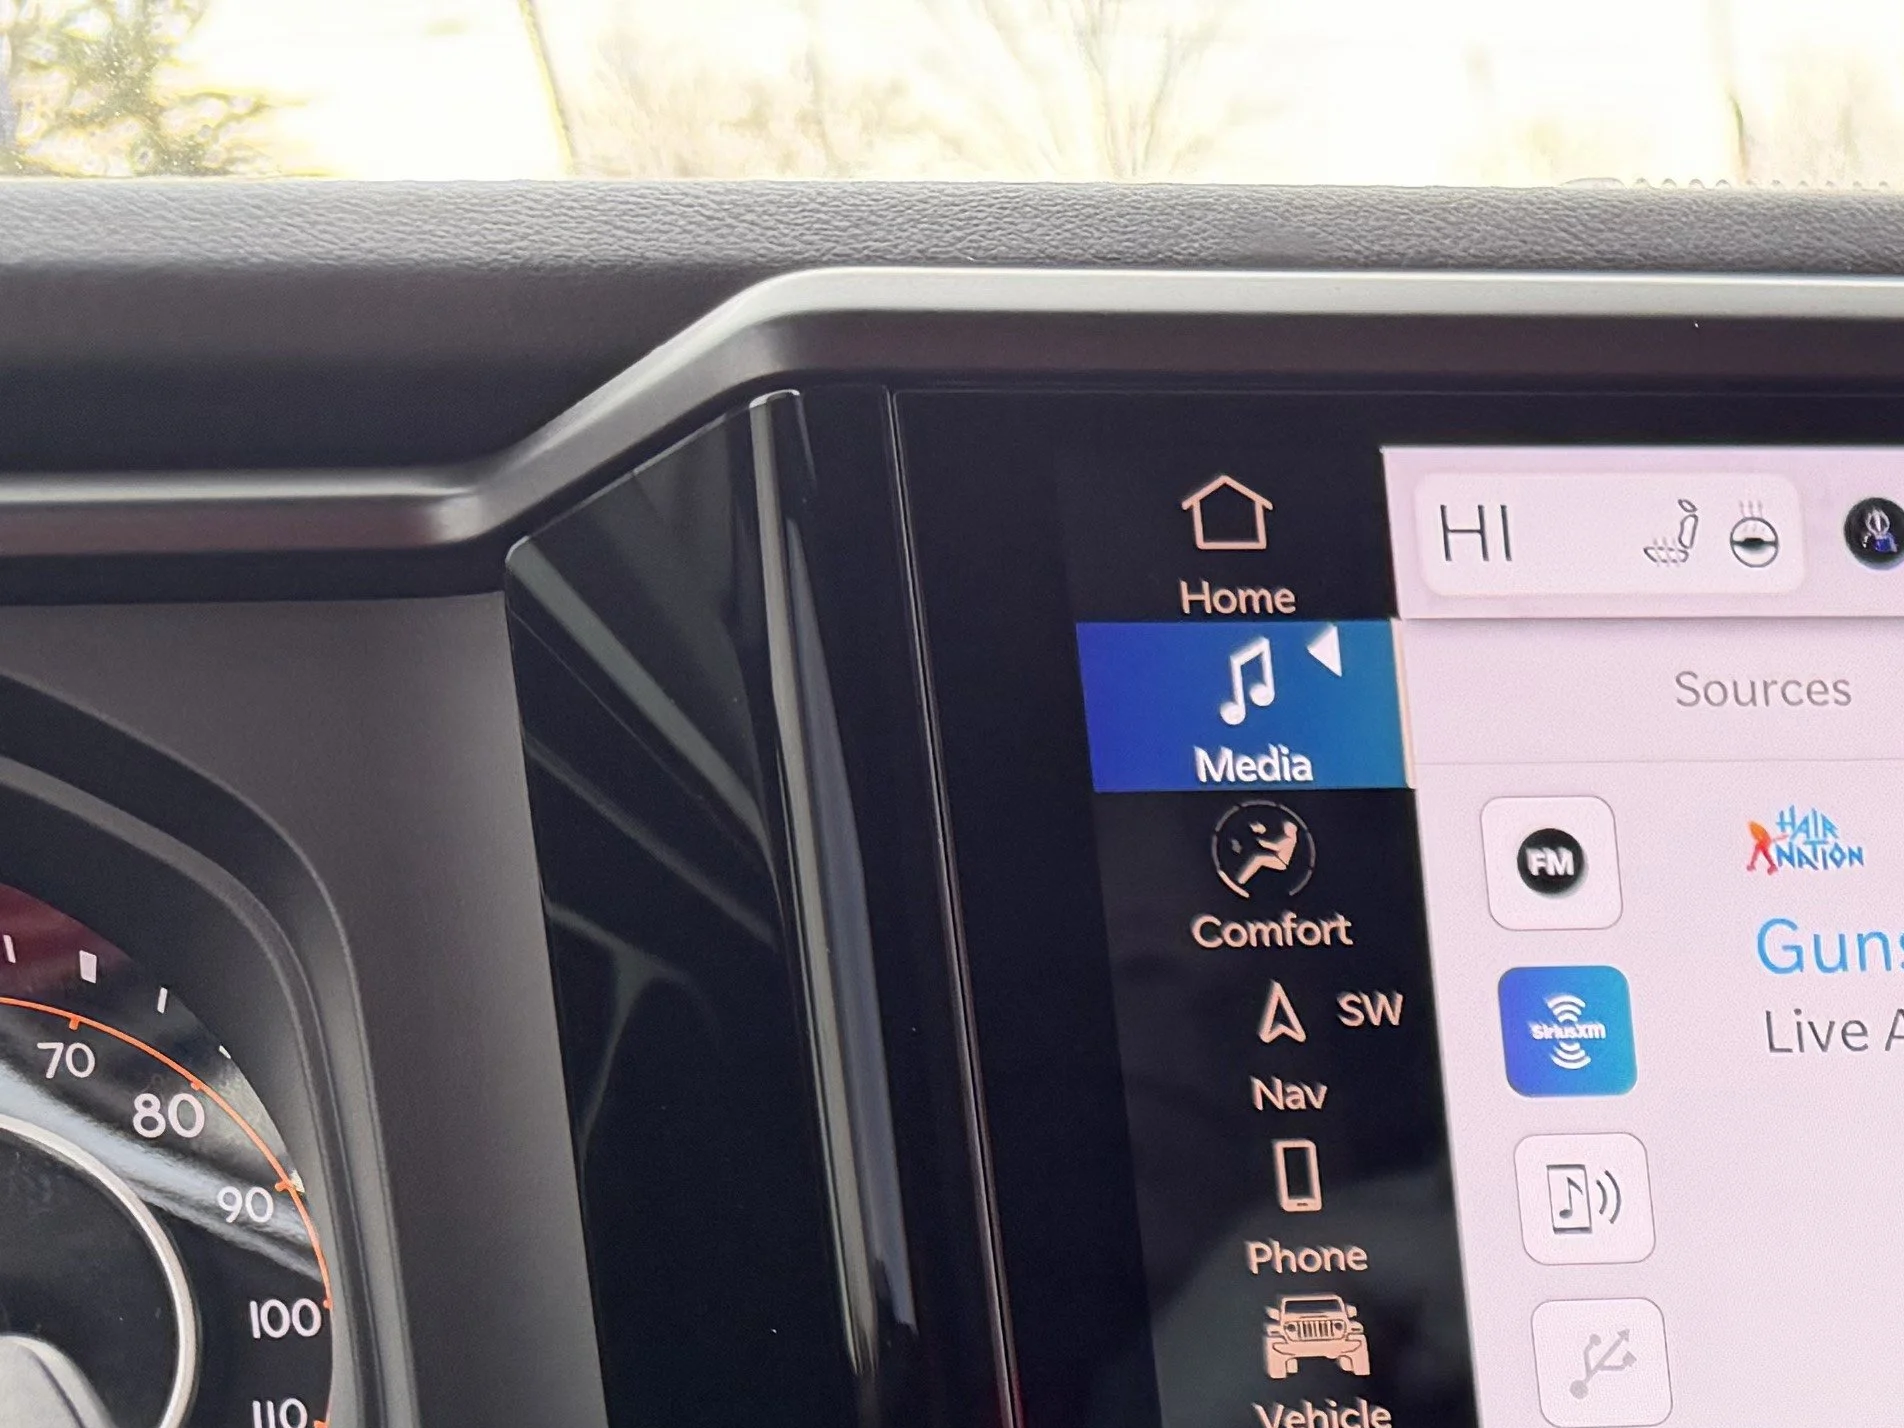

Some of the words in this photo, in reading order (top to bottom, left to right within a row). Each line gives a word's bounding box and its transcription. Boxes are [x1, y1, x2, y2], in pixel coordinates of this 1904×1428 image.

[1440, 503, 1514, 563] HI
[1180, 580, 1297, 615] Home
[1675, 669, 1852, 709] Sources
[1195, 746, 1314, 784] Media
[1776, 805, 1839, 840] HAIR
[1526, 847, 1575, 879] FM
[1775, 839, 1865, 871] NATION
[1191, 913, 1354, 950] Comfort
[1338, 991, 1404, 1027] SW
[1764, 1008, 1869, 1055] Live
[37, 1042, 96, 1079] 70
[1251, 1078, 1327, 1112] Nav
[132, 1092, 205, 1139] 80
[216, 1187, 274, 1223] 90
[1246, 1239, 1369, 1275] Phone
[250, 1298, 321, 1339] 100
